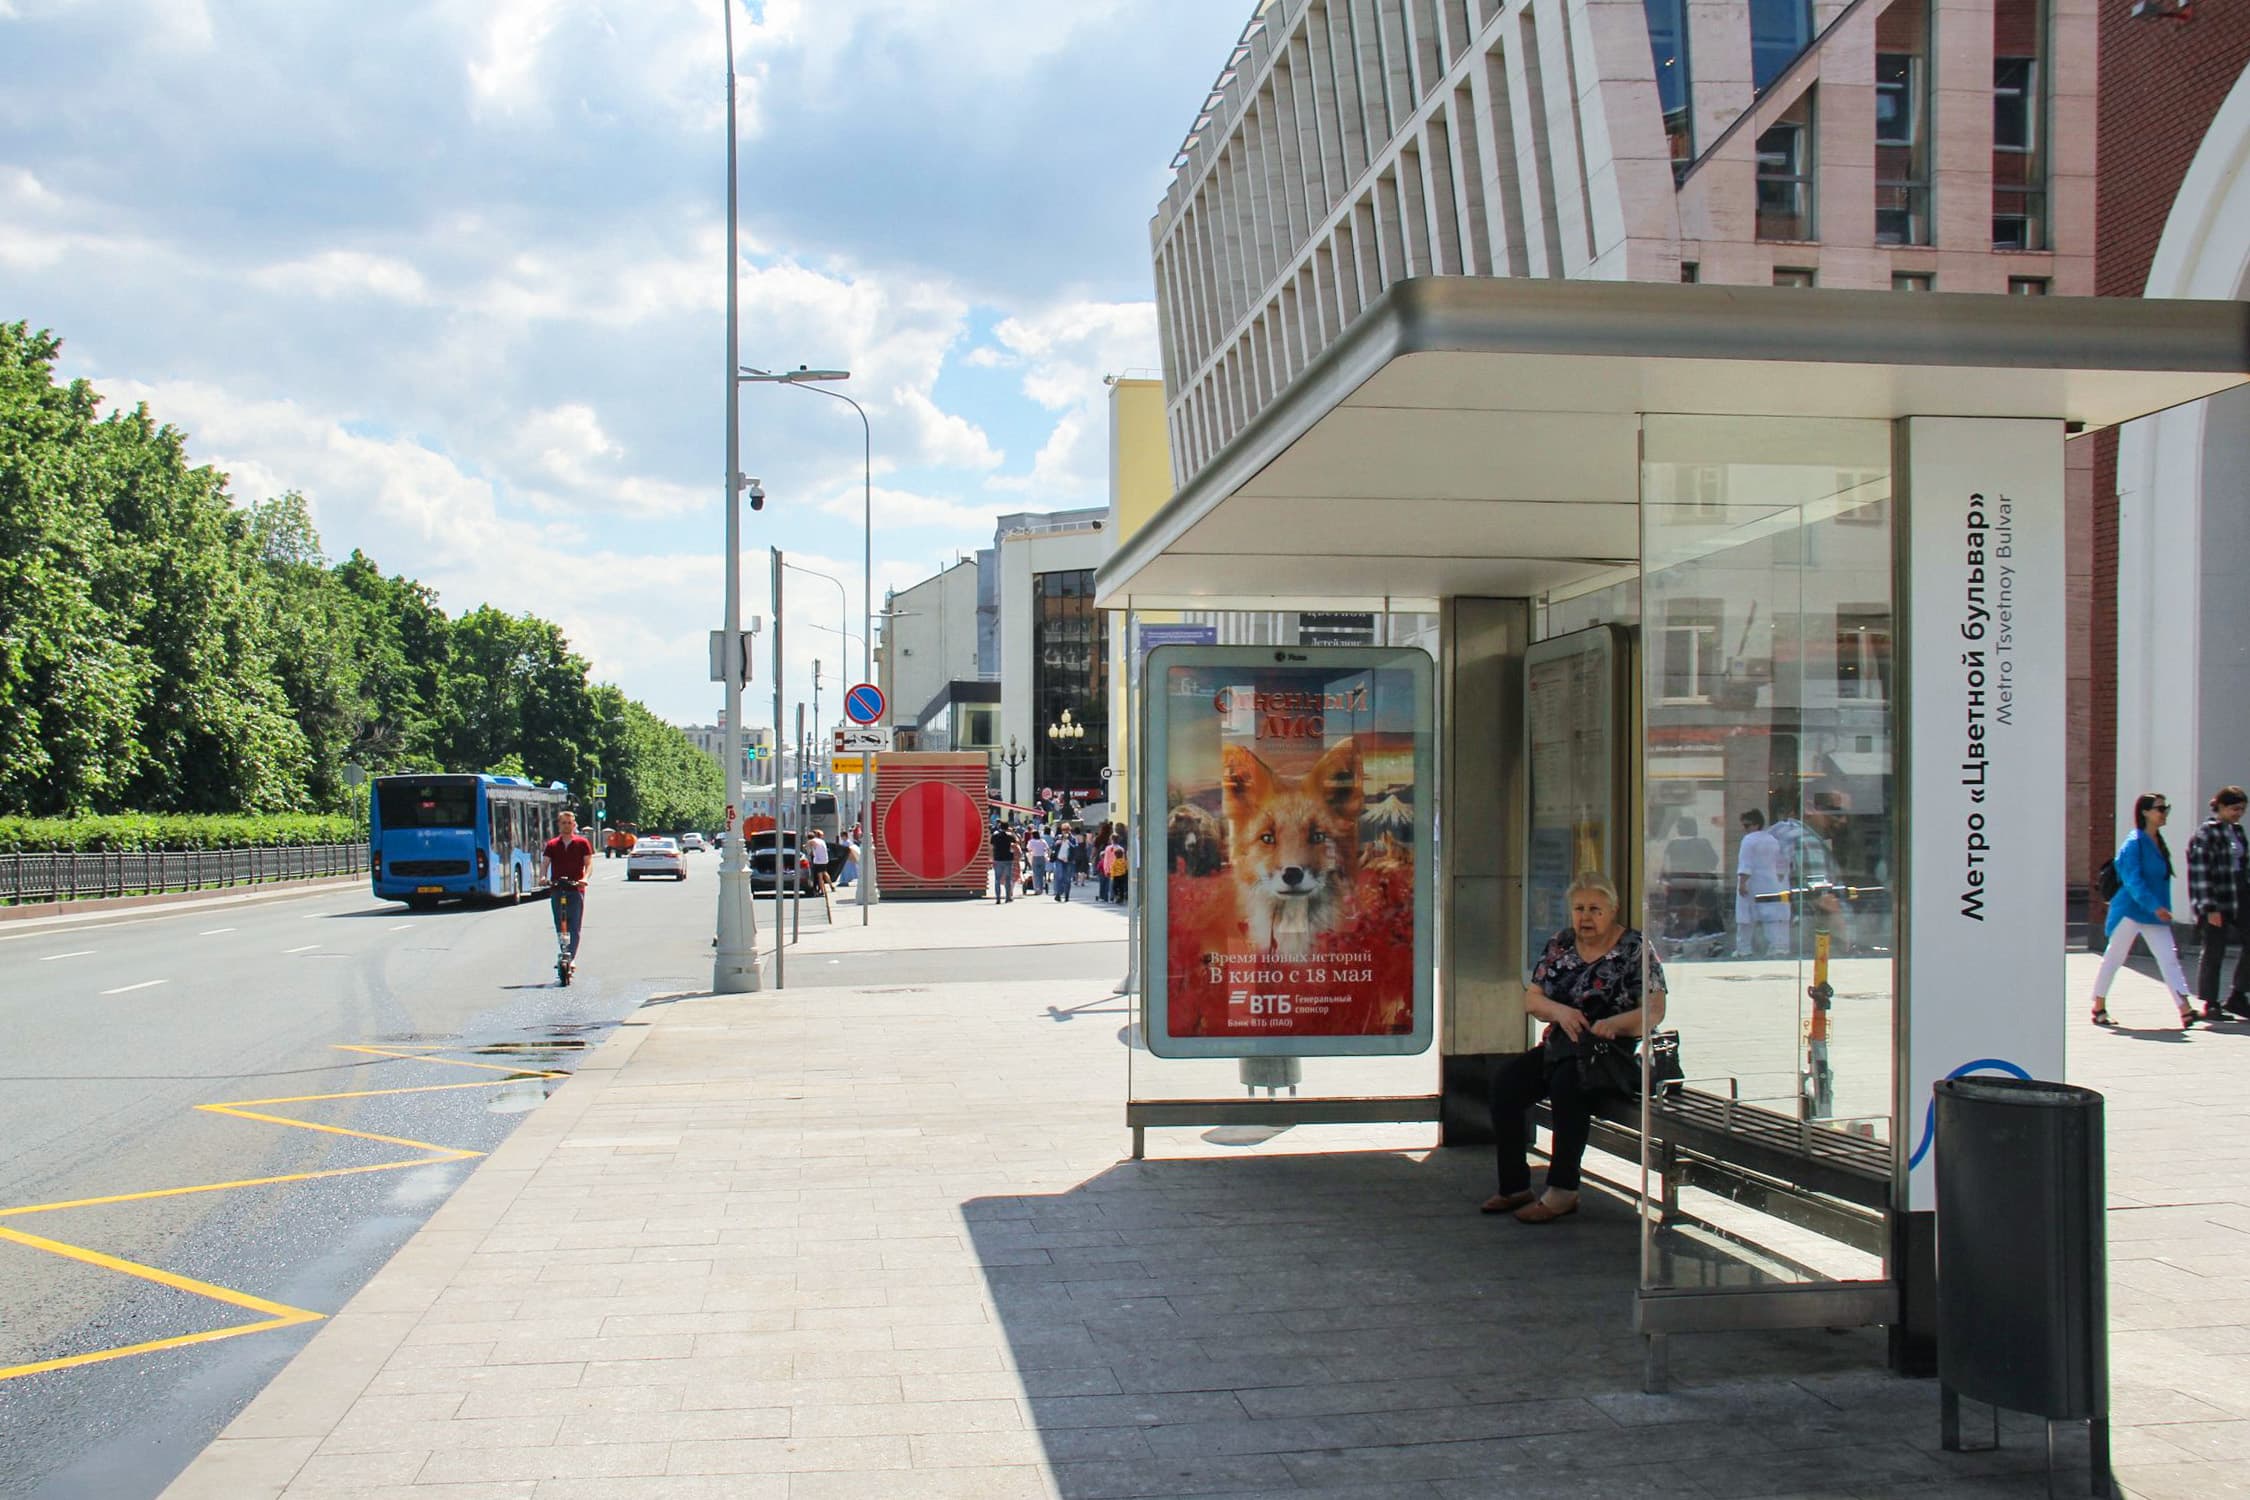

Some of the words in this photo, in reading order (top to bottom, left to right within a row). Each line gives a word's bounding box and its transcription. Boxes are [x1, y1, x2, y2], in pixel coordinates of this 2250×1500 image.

[1995, 494, 2012, 558] Bulvar
[1961, 493, 1990, 641] бульвар»
[1996, 566, 2015, 655] Tsvetnoy
[1996, 661, 2012, 726] Metro
[1961, 652, 1990, 804] «Цветной
[1961, 812, 1990, 921] Метро
[1209, 967, 1223, 984] В
[1229, 970, 1283, 984] кино
[1289, 970, 1299, 984] с
[1305, 968, 1326, 983] 18
[1333, 969, 1373, 983] мая
[1211, 951, 1257, 966] Время
[1261, 953, 1308, 964] новых
[1312, 949, 1372, 966] историй
[1250, 994, 1292, 1014] ВТБ
[1295, 994, 1352, 1005] Генеральный
[1295, 1006, 1329, 1015] спонсор
[1227, 1019, 1249, 1027] Банк
[1251, 1018, 1267, 1027] ВТБ
[1269, 1018, 1293, 1028] (ПАО)
